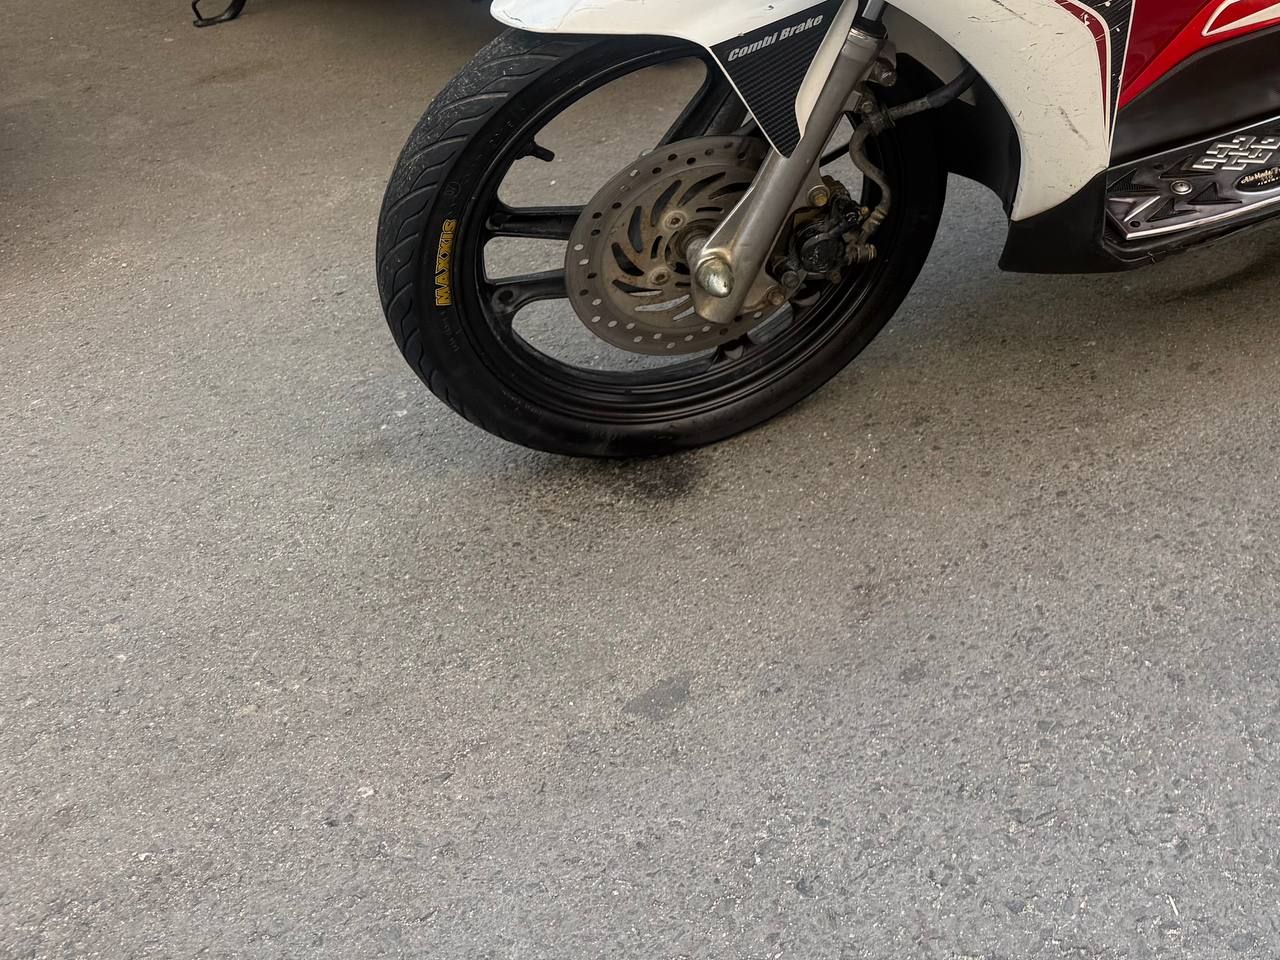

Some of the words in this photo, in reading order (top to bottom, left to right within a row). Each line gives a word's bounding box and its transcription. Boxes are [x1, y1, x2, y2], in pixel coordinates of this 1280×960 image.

[727, 31, 779, 62] Combi
[779, 14, 824, 41] Brake
[434, 218, 457, 306] MAXXIS
